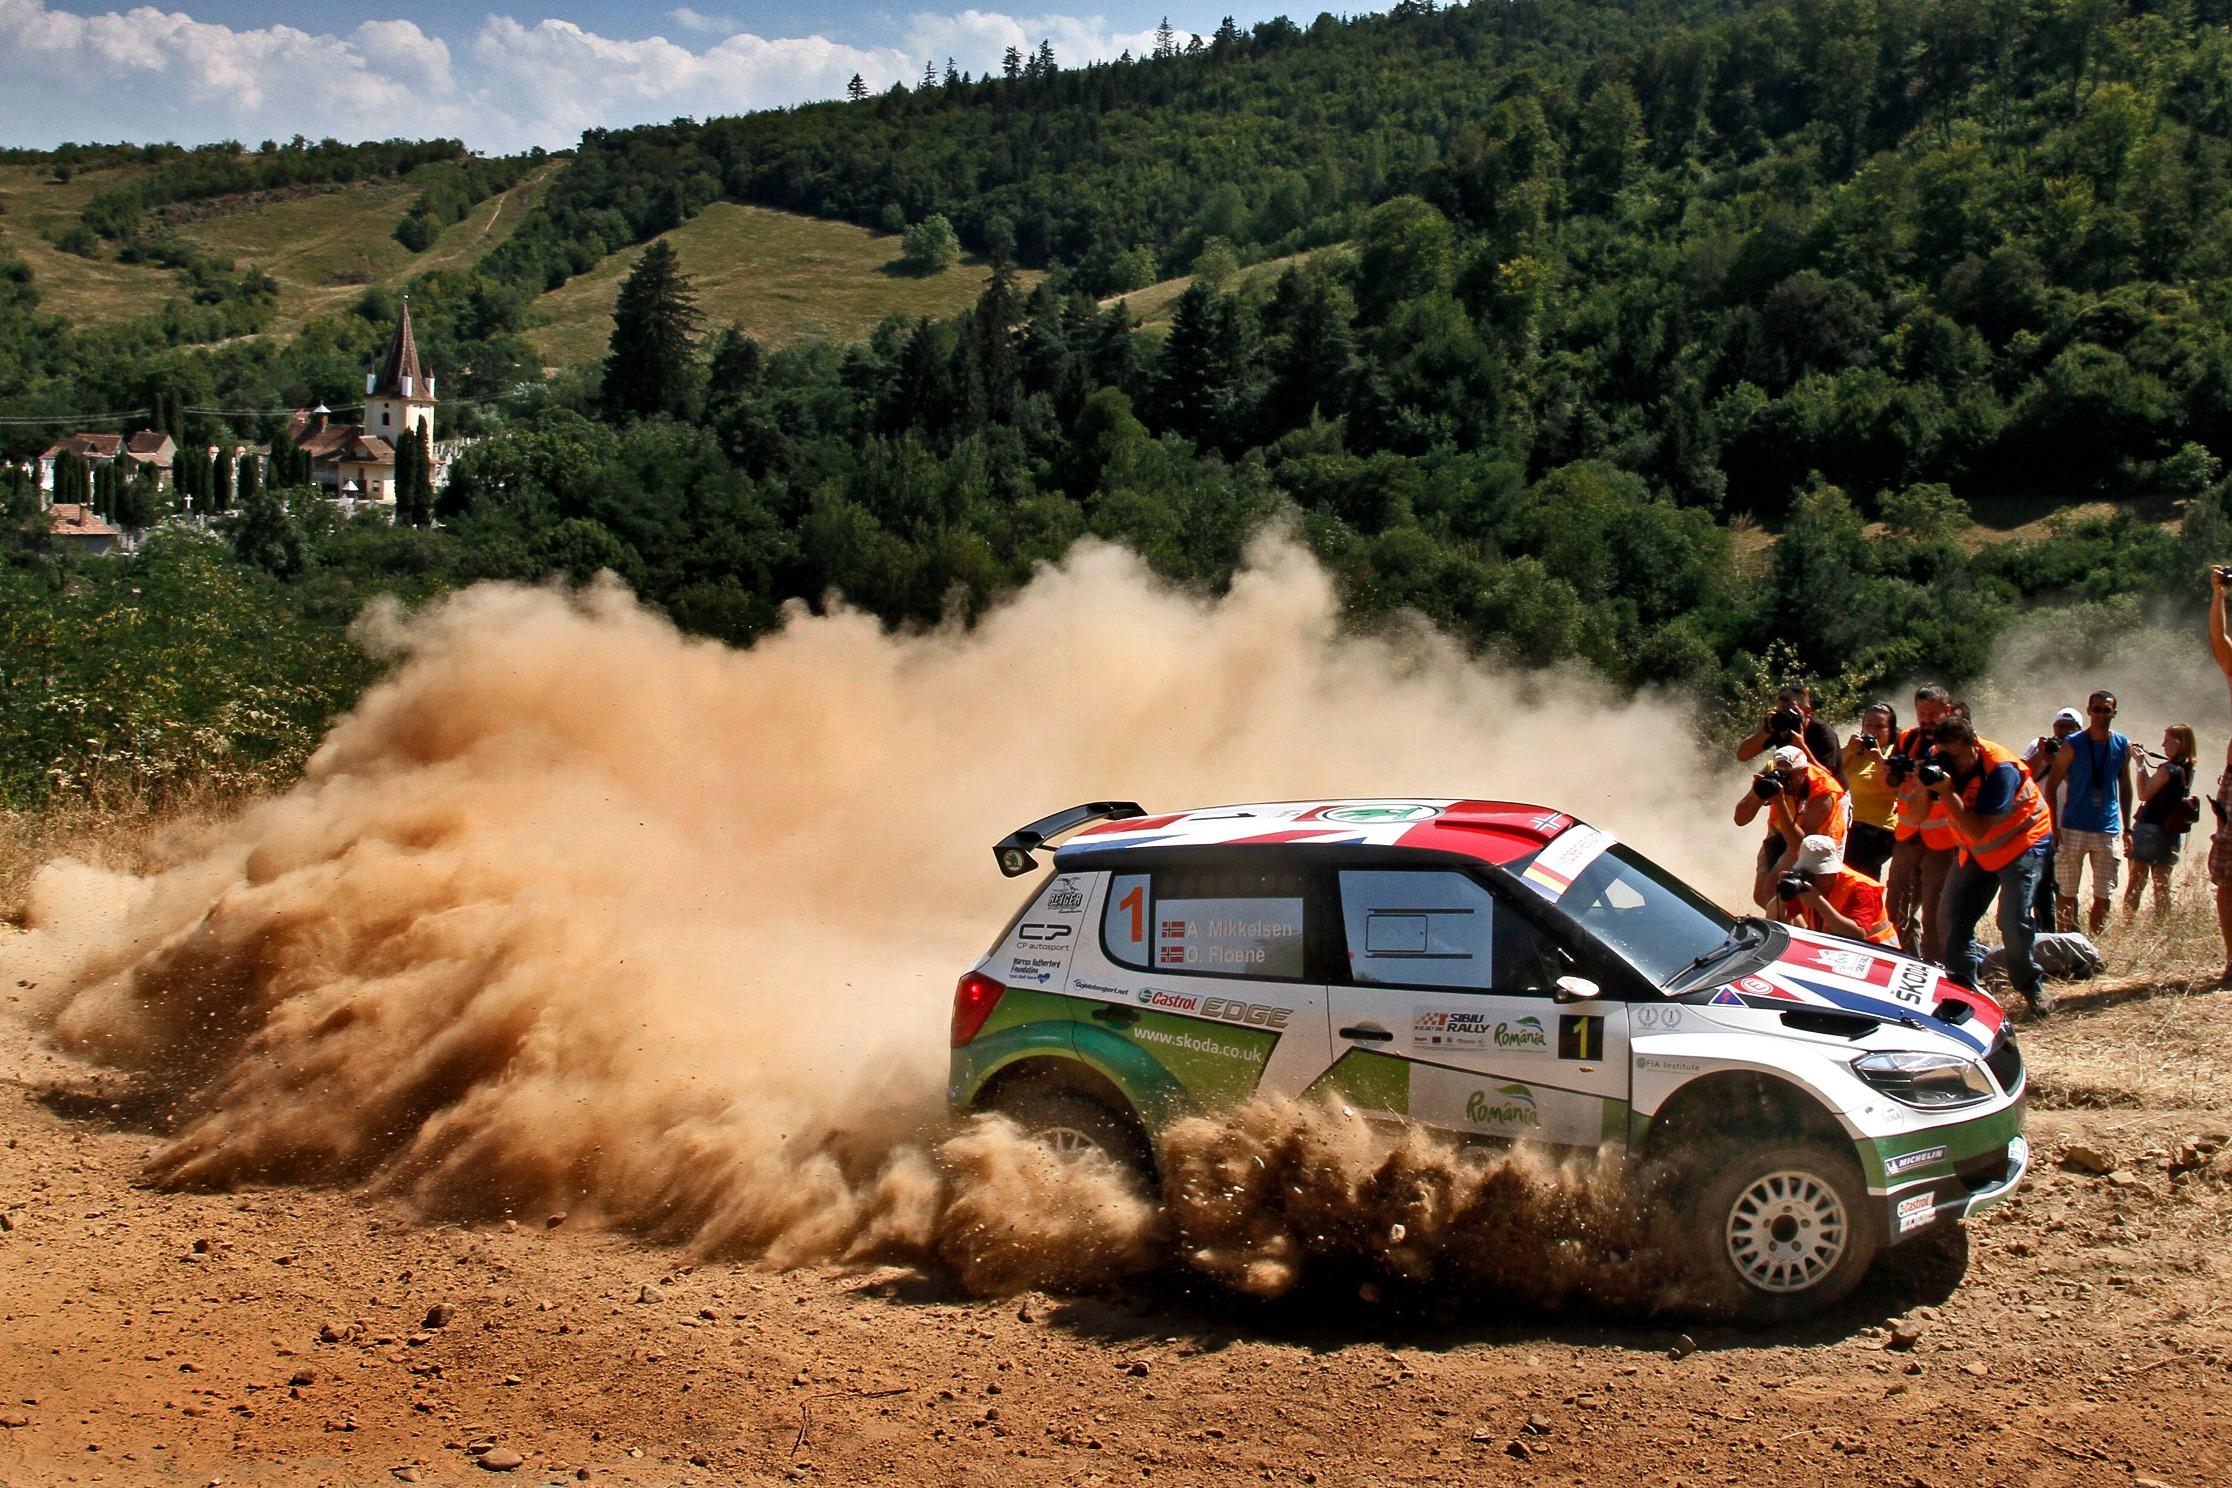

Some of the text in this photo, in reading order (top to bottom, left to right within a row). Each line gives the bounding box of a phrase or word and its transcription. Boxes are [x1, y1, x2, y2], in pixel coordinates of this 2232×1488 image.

[1119, 886, 1143, 943] 1
[1019, 924, 1072, 940] CP
[1209, 920, 1292, 939] Mikkelsen
[1029, 943, 1070, 952] autosport
[1209, 946, 1265, 964] Floene
[1151, 991, 1294, 1029] Castrol EDGE
[1449, 1013, 1485, 1023] SIBIU
[1446, 1023, 1490, 1033] RALLY
[1494, 1022, 1547, 1047] România
[1573, 1016, 1590, 1059] 1
[1134, 1026, 1262, 1063] www.skoda.co.uk
[1646, 1060, 1700, 1071] FIA Institute
[1465, 1090, 1542, 1127] România
[1898, 1149, 1943, 1168] MICHELIN
